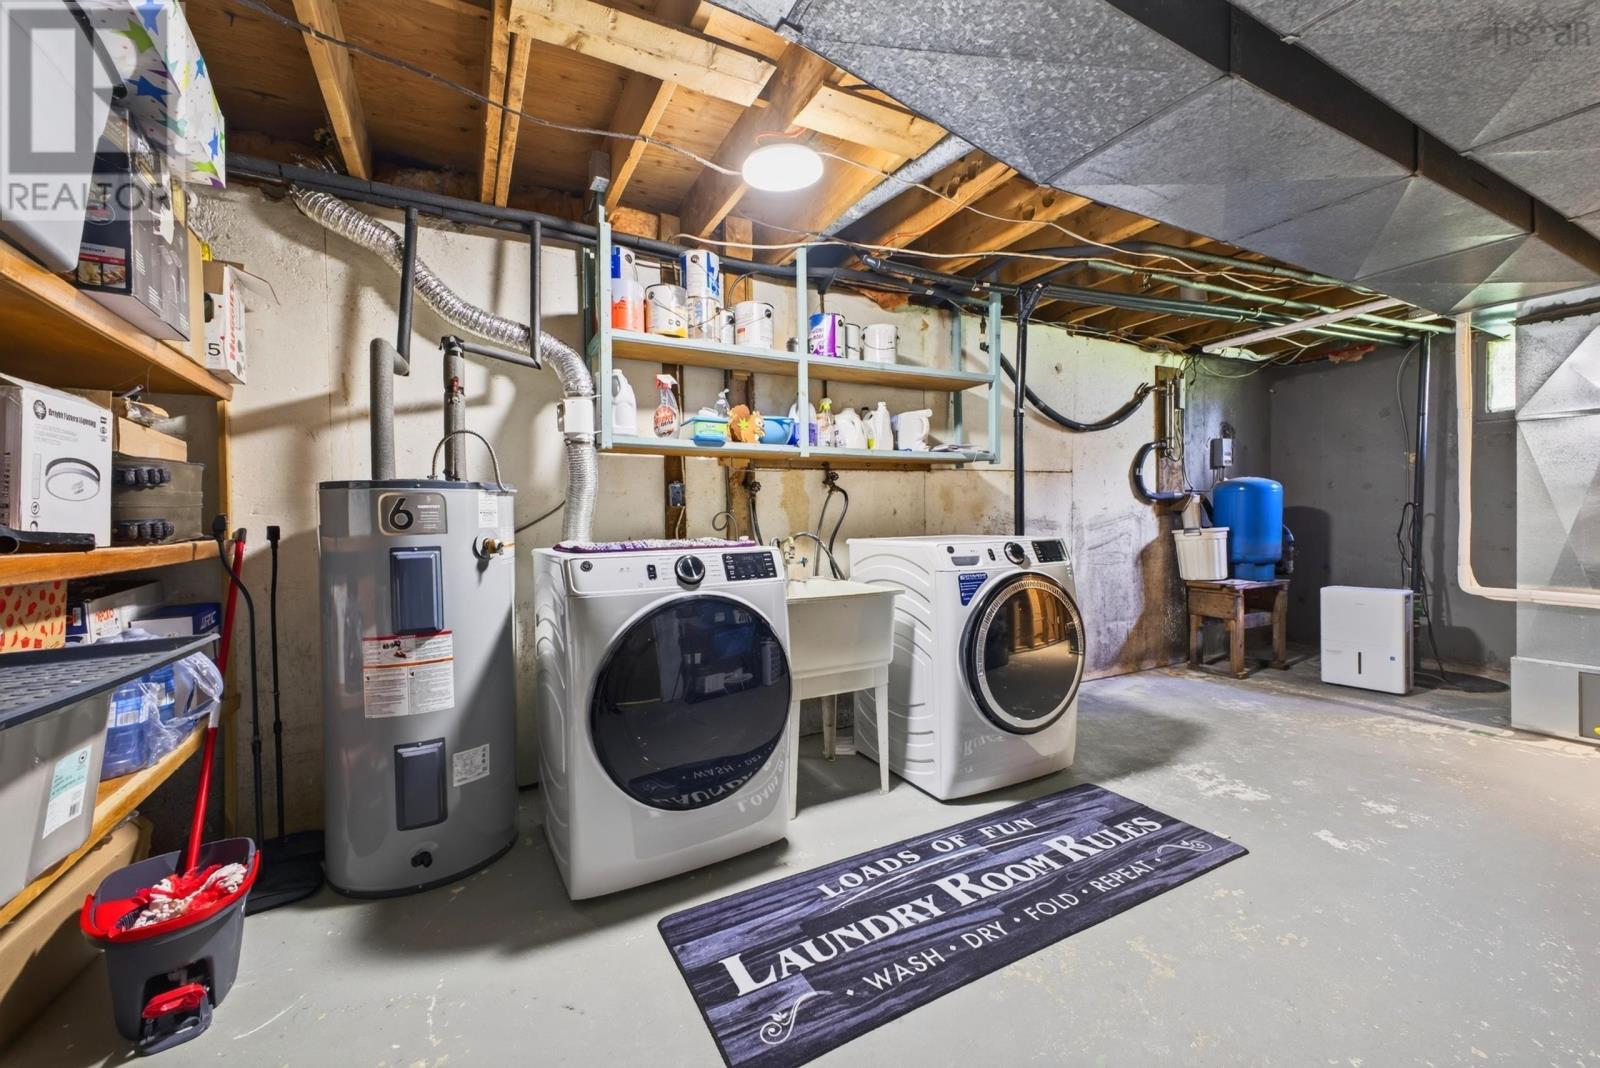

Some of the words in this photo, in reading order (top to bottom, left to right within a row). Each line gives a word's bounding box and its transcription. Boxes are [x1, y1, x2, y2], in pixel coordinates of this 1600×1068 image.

[208, 343, 221, 356] 5
[388, 497, 414, 530] 6
[817, 850, 921, 899] LOADS
[931, 834, 968, 852] OF
[978, 818, 1038, 839] FUN
[862, 947, 946, 991] WASH
[961, 921, 1008, 949] DRY
[1023, 893, 1080, 921] FOLD
[1089, 860, 1155, 893] REPEAT
